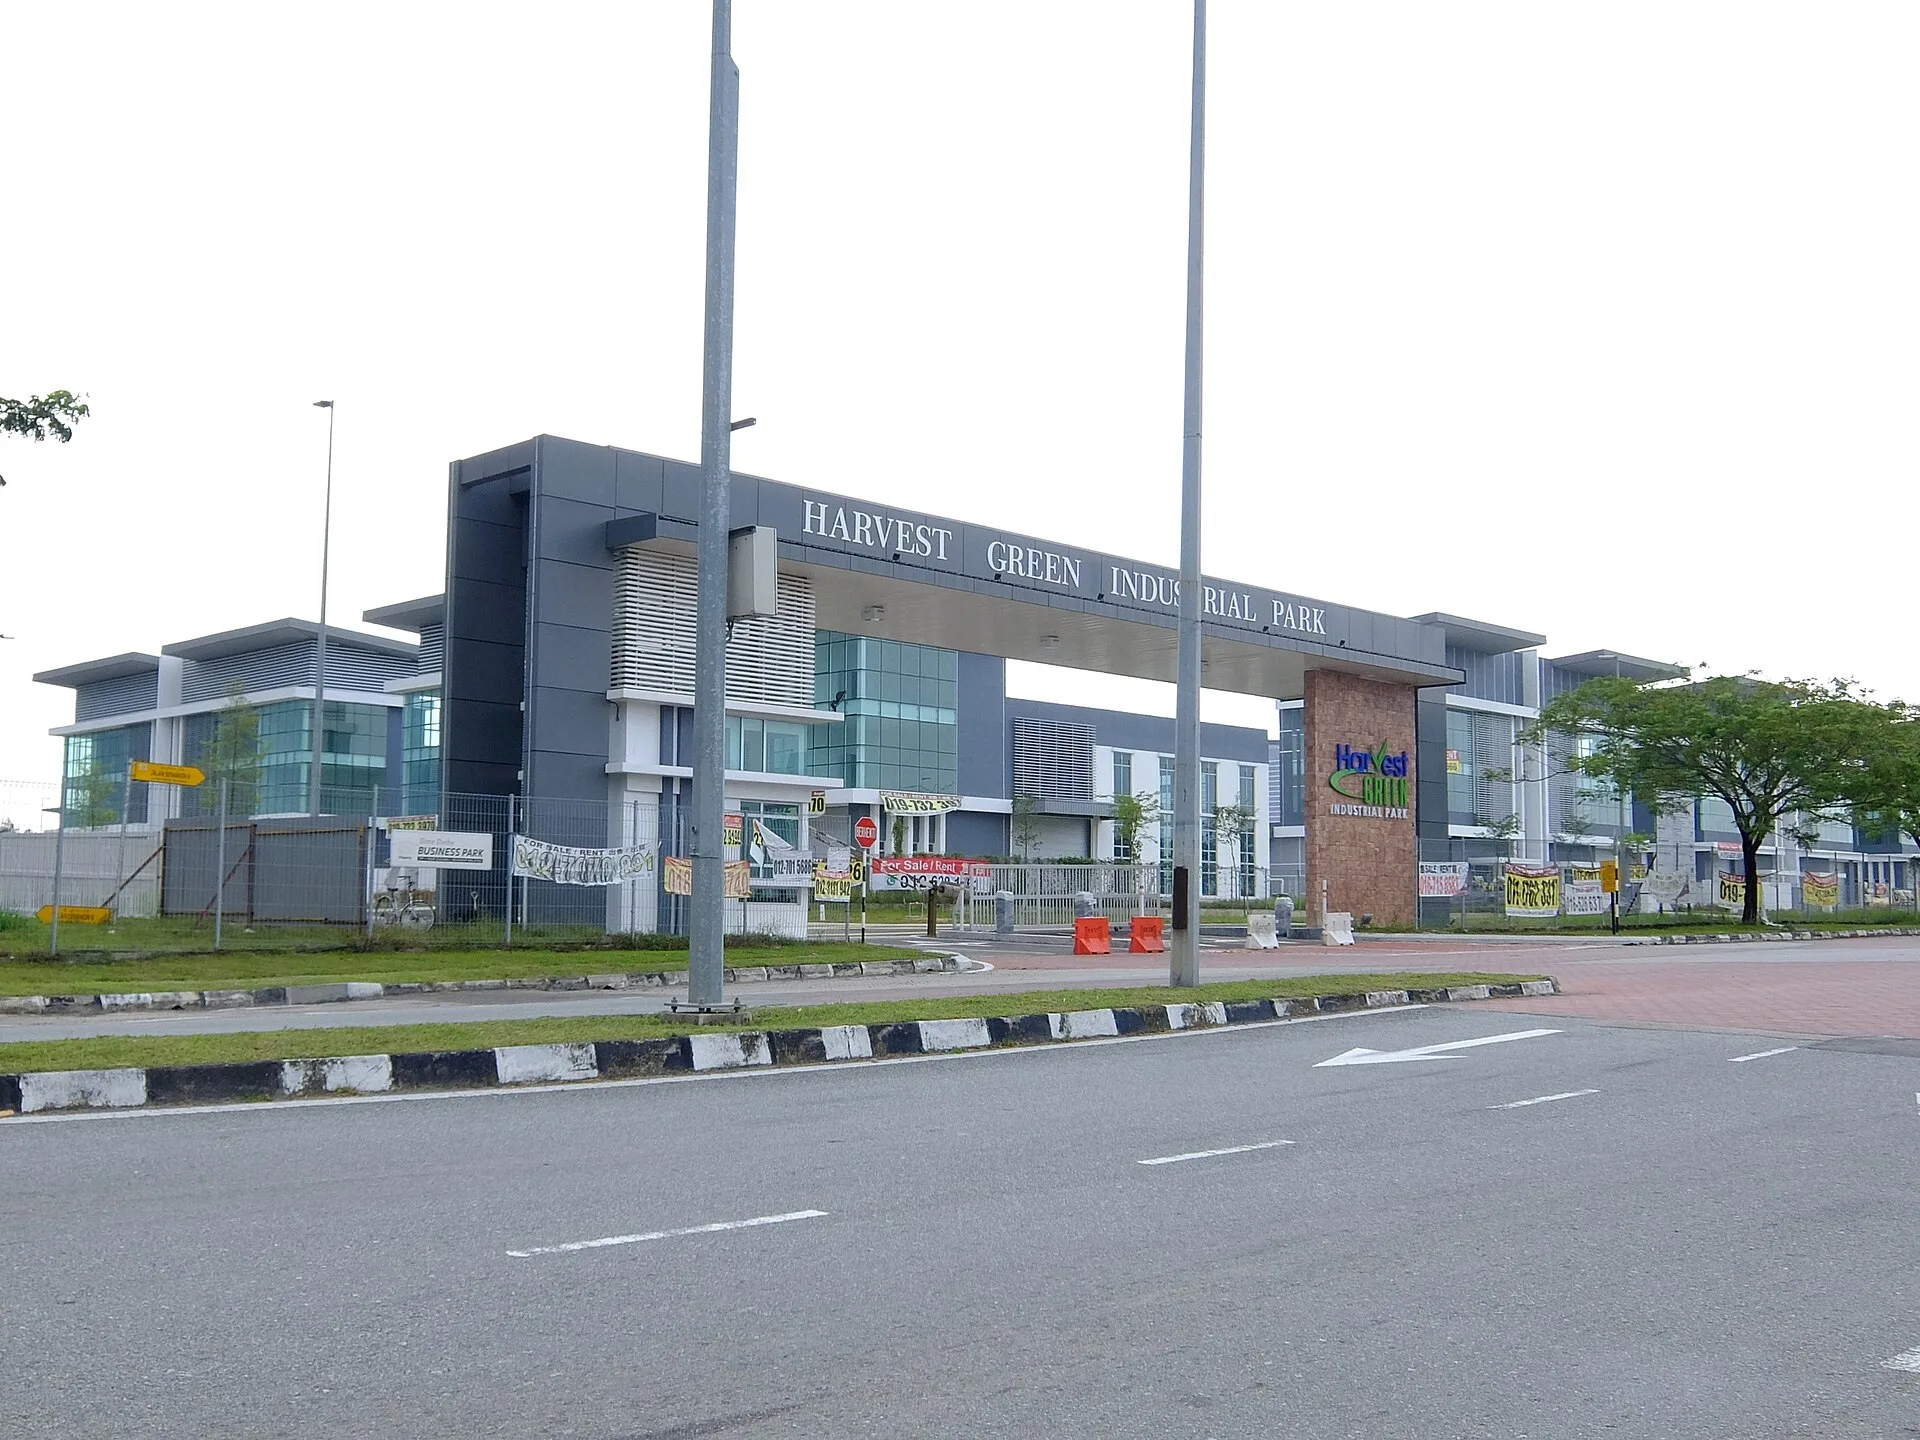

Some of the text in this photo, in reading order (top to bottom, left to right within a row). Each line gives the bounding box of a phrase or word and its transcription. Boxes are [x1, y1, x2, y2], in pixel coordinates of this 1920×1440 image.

[802, 499, 1327, 635] HARVEST GREEN INDURIAL PARK
[884, 796, 937, 811] 019-732
[1331, 804, 1409, 819] INDUSTRIAL PARK
[417, 846, 484, 857] BUSINESS PARK
[524, 839, 543, 849] FOR
[545, 844, 572, 855] SALE
[773, 860, 796, 875] 012-701
[880, 860, 901, 871] For
[903, 860, 929, 871] Sale
[935, 861, 956, 872] Rent
[1720, 880, 1746, 903] 019-
